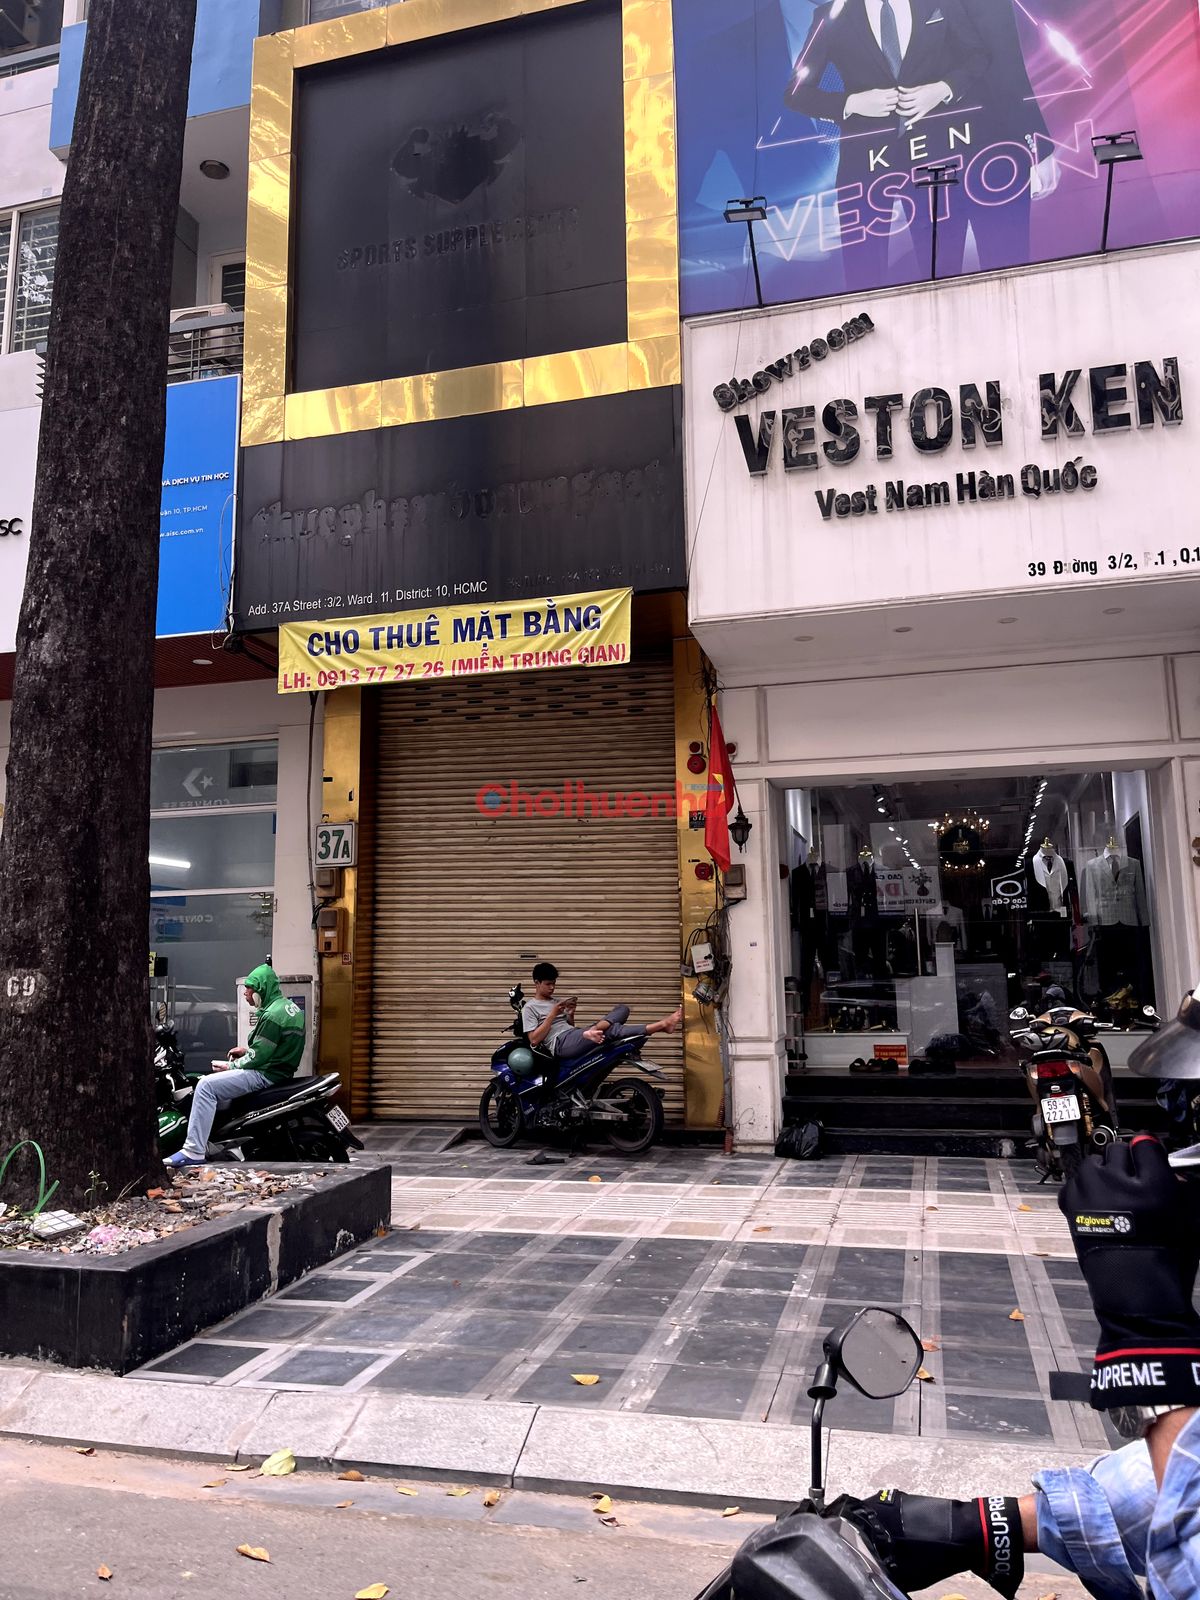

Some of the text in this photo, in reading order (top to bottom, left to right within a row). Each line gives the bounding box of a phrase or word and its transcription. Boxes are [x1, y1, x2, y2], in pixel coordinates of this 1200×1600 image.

[869, 122, 971, 172] KEN
[762, 118, 1099, 262] VESTON
[713, 312, 875, 412] Showroom
[734, 356, 1184, 476] VESTON KEN
[201, 473, 213, 482] TIN
[815, 456, 1098, 520] Vest Nam Hàn Quốc
[1028, 562, 1046, 577] 39
[1053, 559, 1098, 576] Đờng
[1107, 552, 1138, 571] 3/2,
[272, 601, 291, 614] 37A
[293, 598, 321, 611] Street
[454, 580, 488, 595] HCMC
[307, 598, 602, 657] CHO THUÊ MẶT BẰNG
[283, 672, 311, 690] LH:
[317, 668, 360, 688] 0913
[366, 665, 388, 682] 77
[393, 663, 416, 680] 27
[422, 661, 445, 679] 26
[510, 649, 571, 669] TRUNG
[317, 829, 351, 860] 37A
[7, 975, 36, 997] 69
[1090, 1362, 1166, 1390] SUPREME
